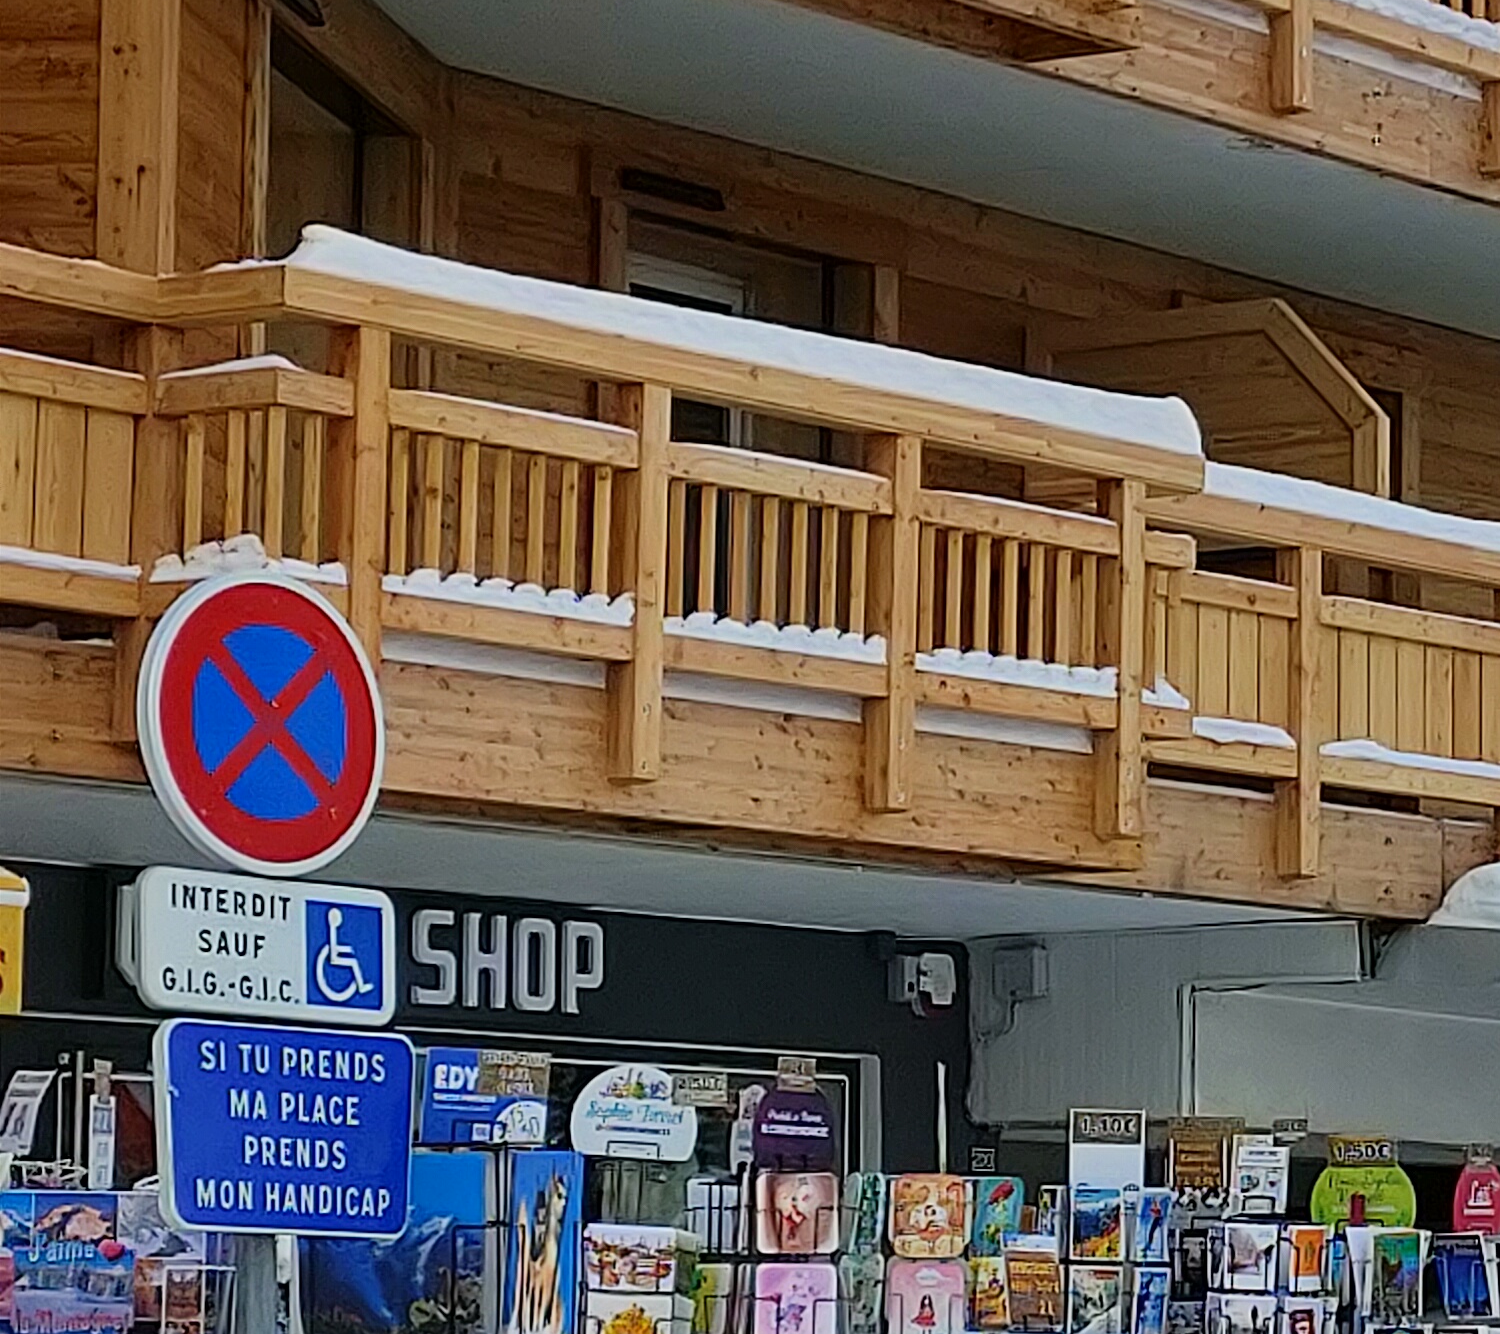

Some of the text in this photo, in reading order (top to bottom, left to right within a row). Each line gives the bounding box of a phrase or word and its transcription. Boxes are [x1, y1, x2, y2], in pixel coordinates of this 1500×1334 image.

[171, 882, 292, 921] INTERDIT
[198, 928, 267, 959] SAUF
[410, 908, 604, 1015] SHOP
[200, 1039, 386, 1083] SI TU PRENDS
[229, 1087, 361, 1126] MA PLACE
[244, 1134, 348, 1170] PRENDS
[195, 1178, 391, 1218] MON HANDICAP
[28, 1232, 96, 1264] J'aime
